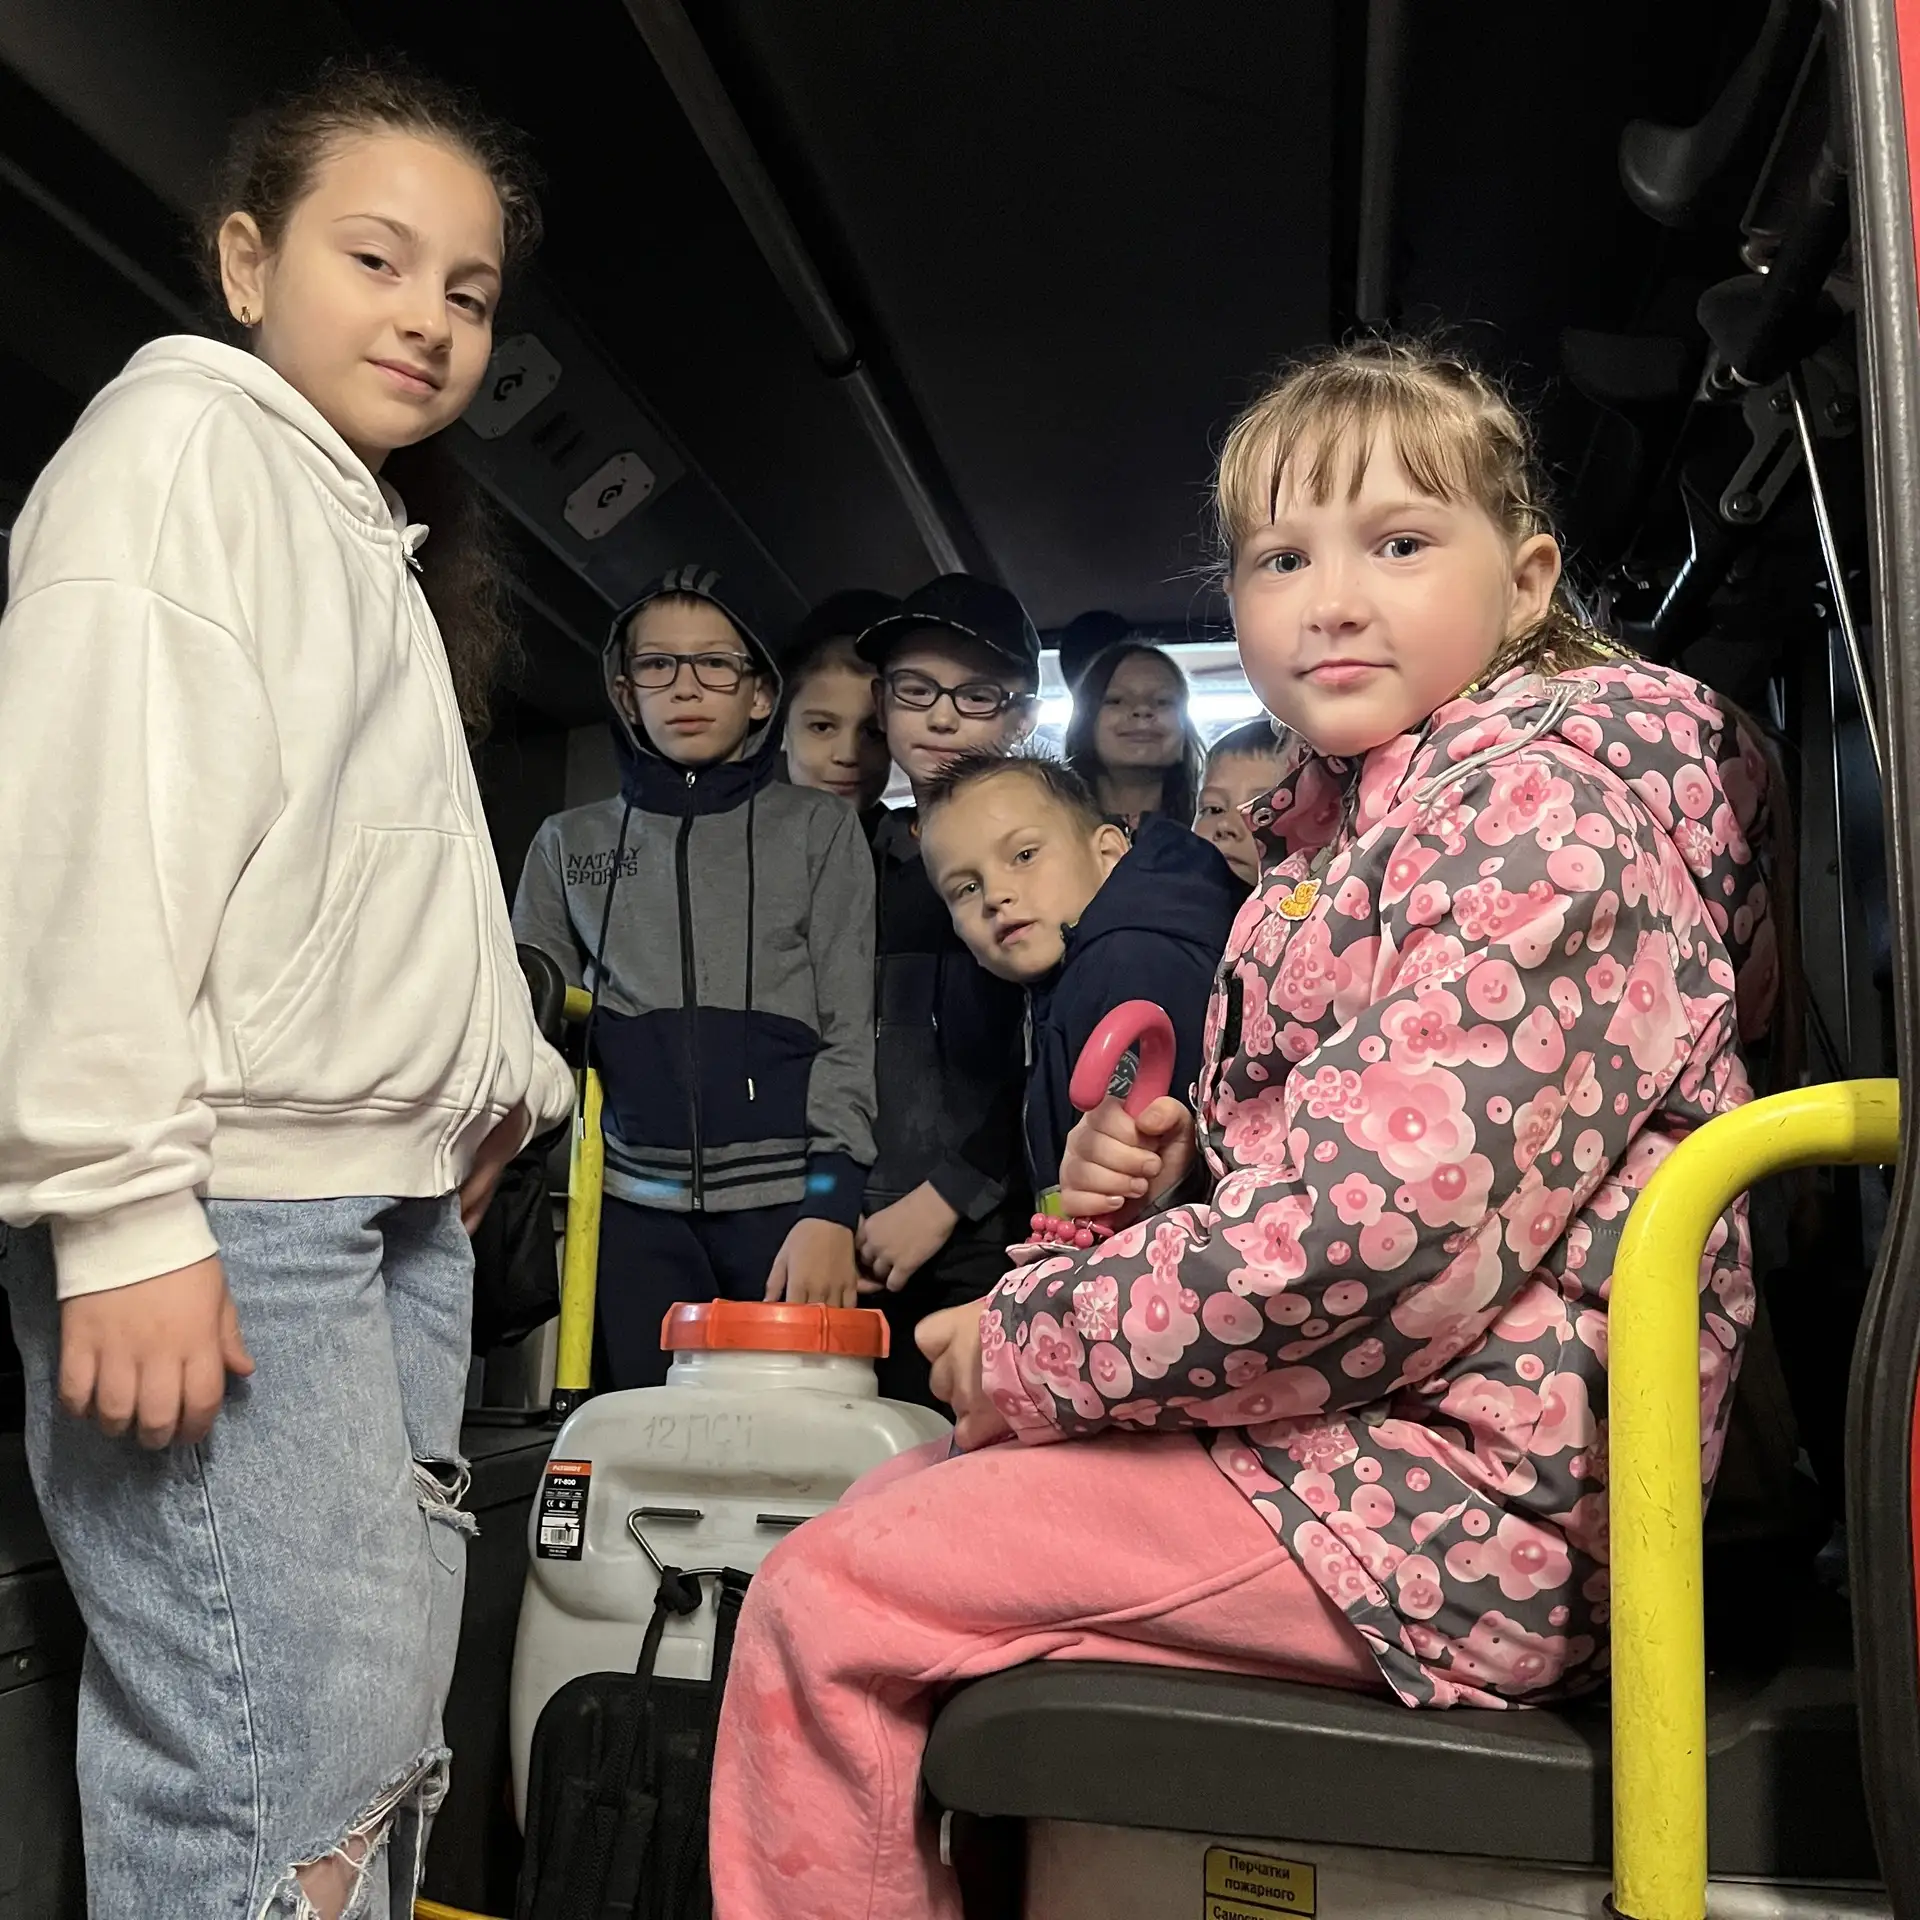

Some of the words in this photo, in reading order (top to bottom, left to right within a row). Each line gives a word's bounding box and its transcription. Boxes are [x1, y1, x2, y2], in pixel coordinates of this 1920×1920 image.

[1229, 1855, 1290, 1880] Перчатки
[1224, 1878, 1295, 1902] пожарного
[1213, 1906, 1265, 1920] Само
